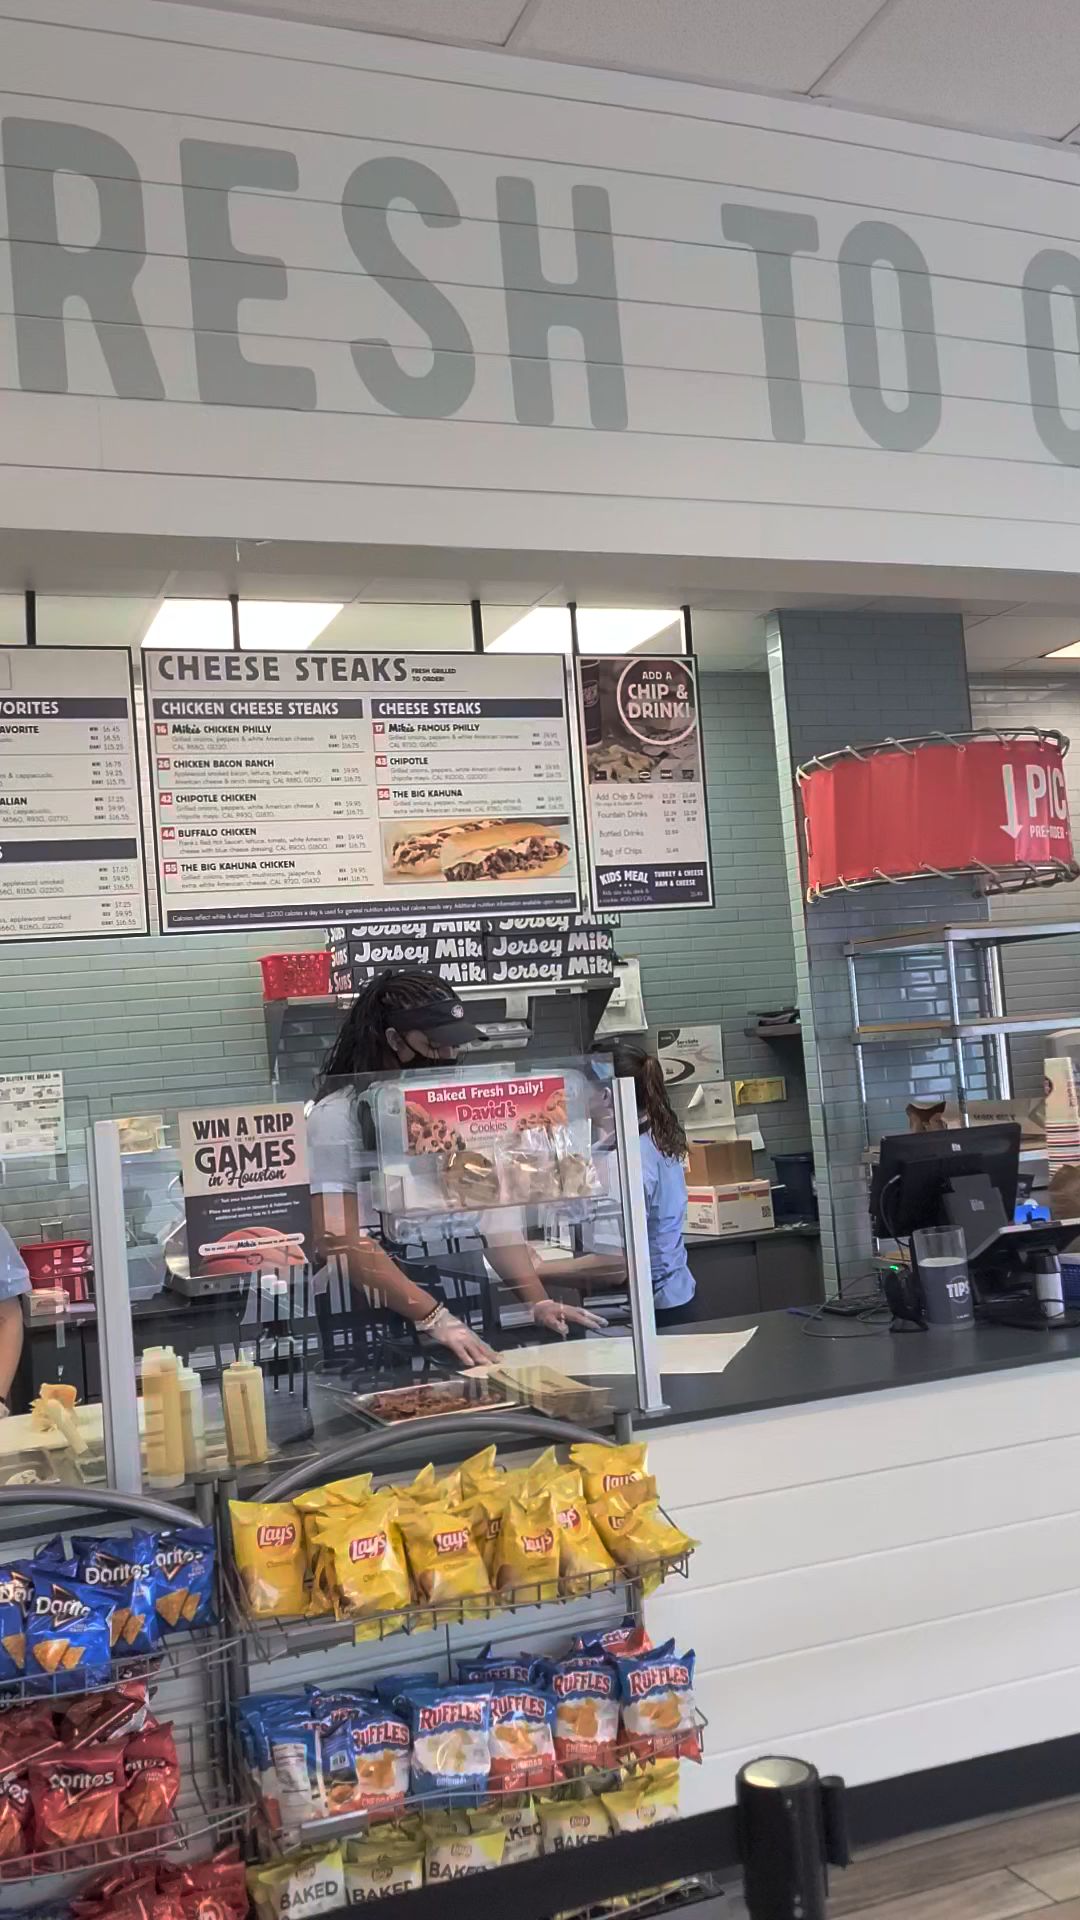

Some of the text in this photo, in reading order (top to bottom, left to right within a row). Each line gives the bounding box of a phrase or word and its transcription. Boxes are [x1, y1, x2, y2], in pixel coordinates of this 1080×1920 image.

[721, 203, 942, 452] TO
[158, 656, 407, 681] CHEESE STEAKS
[642, 671, 673, 680] ADD A
[627, 684, 688, 700] CHIP &
[0, 702, 59, 714] ORITES
[161, 702, 340, 715] CHICKEN CHEESE STEAKS
[379, 702, 482, 715] CHEESE STEAKS
[627, 702, 692, 719] DRINK!
[0, 726, 40, 734] AVORITE
[203, 726, 240, 734] CHICKEN
[242, 725, 273, 734] PHILLY
[417, 724, 451, 732] FAMOUS
[452, 724, 480, 732] PHILLY
[173, 760, 210, 768] CHICKEN
[213, 760, 242, 768] BACON
[245, 759, 275, 768] RANCH
[389, 757, 429, 765] CHIPOTLE
[392, 791, 409, 799] THE
[411, 790, 426, 799] BIG
[428, 789, 462, 798] KAHUNA
[596, 793, 609, 801] Add
[178, 829, 218, 837] BUFFALO
[221, 828, 257, 836] CHICKEN
[181, 864, 198, 872] THE
[200, 863, 217, 871] BIG
[219, 862, 258, 871] KAHUNA
[259, 861, 296, 870] CHICKEN
[654, 871, 677, 879] TURKEY
[684, 870, 704, 878] CHEESE
[599, 870, 650, 886] KIDS MEAL
[676, 880, 696, 888] CHEESE
[355, 942, 429, 964] Jersey
[492, 936, 562, 957] Jersey
[492, 961, 562, 982] Jersey
[427, 1080, 545, 1103] Baked Fresh Daily!
[456, 1100, 518, 1122] David's
[193, 1113, 294, 1140] WIN A TRIP
[469, 1122, 508, 1134] Cookies
[194, 1139, 296, 1175] GAMES
[209, 1168, 287, 1188] in Houston
[946, 1280, 970, 1298] TIPS
[155, 1546, 204, 1568] oritos
[85, 1562, 151, 1586] Doritos
[35, 1596, 92, 1616] Dorito
[553, 1670, 612, 1698] RUFFLES
[628, 1663, 690, 1697] RUFFLES
[419, 1701, 483, 1731] RUFFLES
[491, 1695, 547, 1722] RUFFLES
[504, 1822, 542, 1843] KED
[554, 1834, 612, 1852] BAK
[429, 1861, 488, 1881] BAK
[280, 1880, 339, 1911] BAKED
